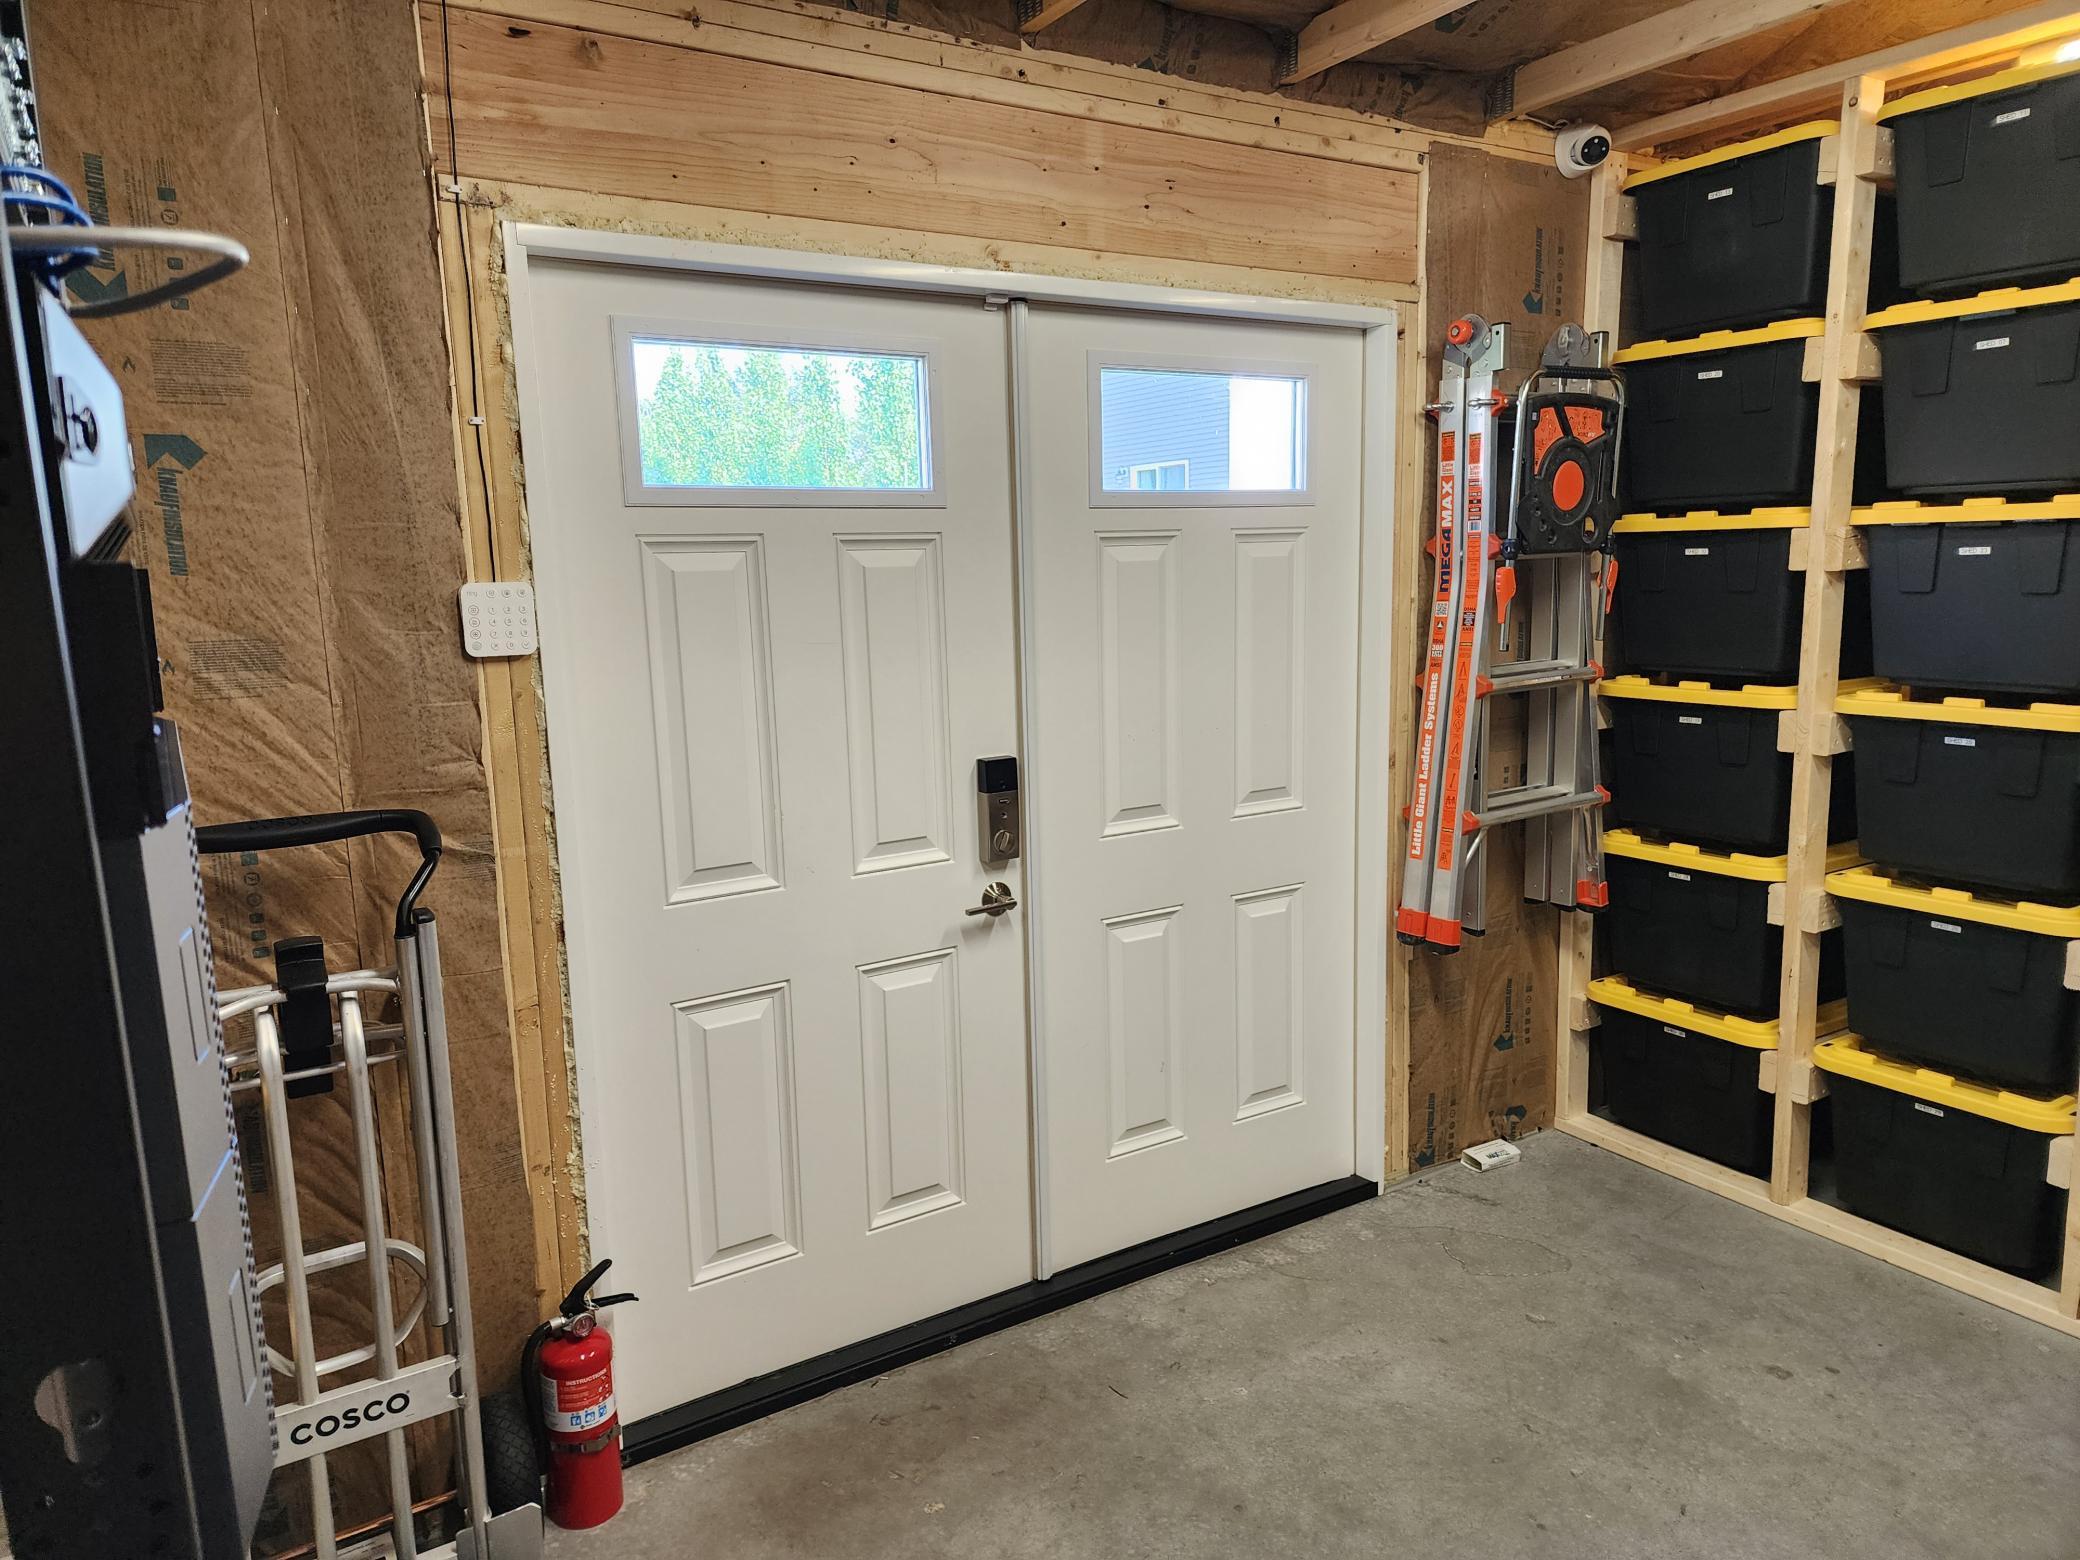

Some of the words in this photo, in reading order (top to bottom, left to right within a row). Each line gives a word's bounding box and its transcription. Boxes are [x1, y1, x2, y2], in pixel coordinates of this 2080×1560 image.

[1977, 340, 1996, 349] SHED
[1960, 546, 1977, 555] SHED
[1424, 672, 1439, 730] Systems
[1418, 734, 1432, 780] Ladder
[1415, 782, 1427, 818] Giant
[1411, 820, 1424, 856] Little
[290, 1391, 411, 1446] COSCO
